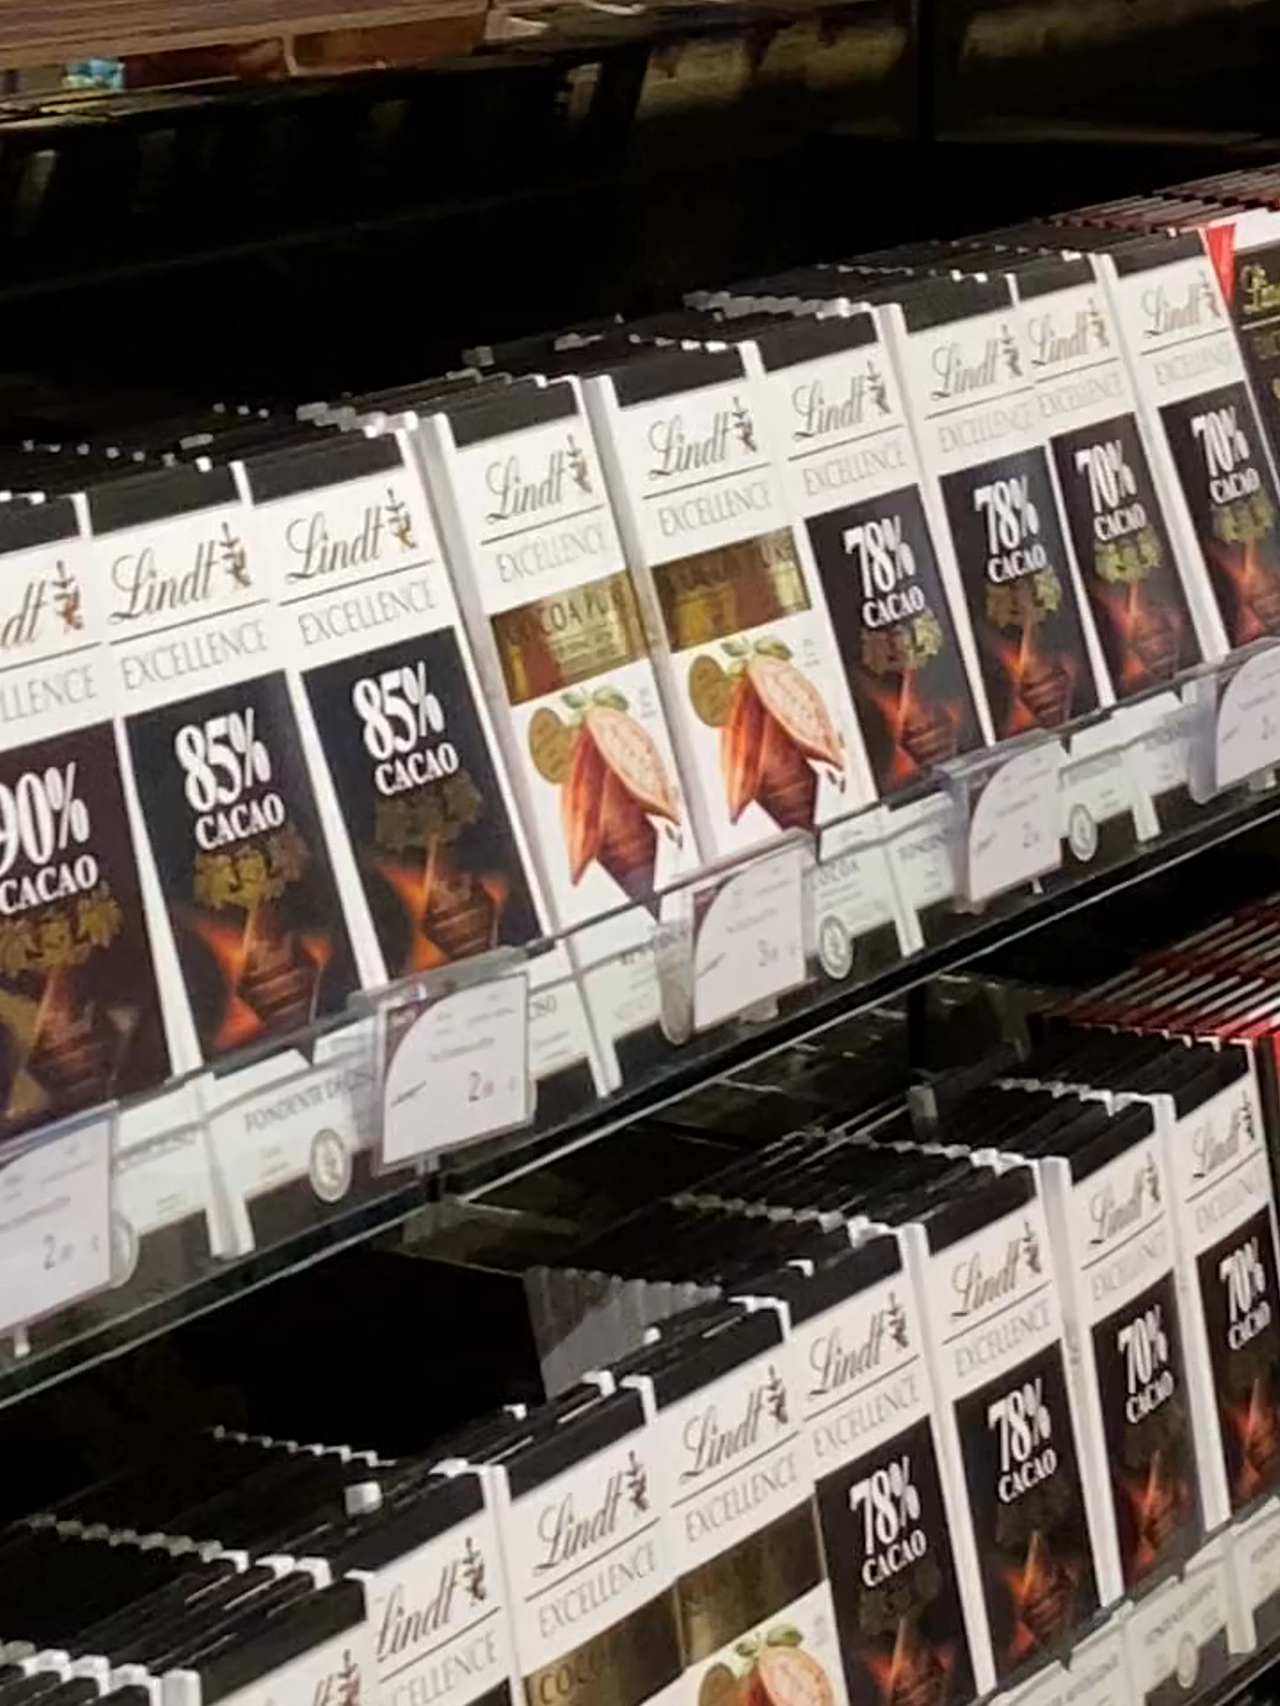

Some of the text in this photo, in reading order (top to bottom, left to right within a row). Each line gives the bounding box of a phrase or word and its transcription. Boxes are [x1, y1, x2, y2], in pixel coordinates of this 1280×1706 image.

[931, 334, 1001, 400] Lindt
[647, 413, 728, 480] Lindt
[794, 378, 864, 442] Lindt
[486, 450, 566, 524] Lindt
[975, 475, 1038, 554] 78%
[286, 504, 384, 586] Lindt
[845, 515, 917, 597] 78%
[110, 544, 220, 625] Lindt
[298, 581, 438, 645] EXCELLENCE
[862, 588, 925, 628] CACAO
[119, 622, 270, 691] EXCELLENCE
[352, 662, 445, 762] 85%
[175, 708, 270, 814] 85%
[375, 743, 459, 796] CACAO
[196, 794, 286, 850] CACAO
[948, 1252, 1026, 1318] Lindt
[807, 1326, 885, 1398] Lindt
[681, 1403, 764, 1484] Lindt
[988, 1376, 1052, 1471] 78%
[536, 1486, 624, 1574] Lindt
[850, 1456, 920, 1557] 78%
